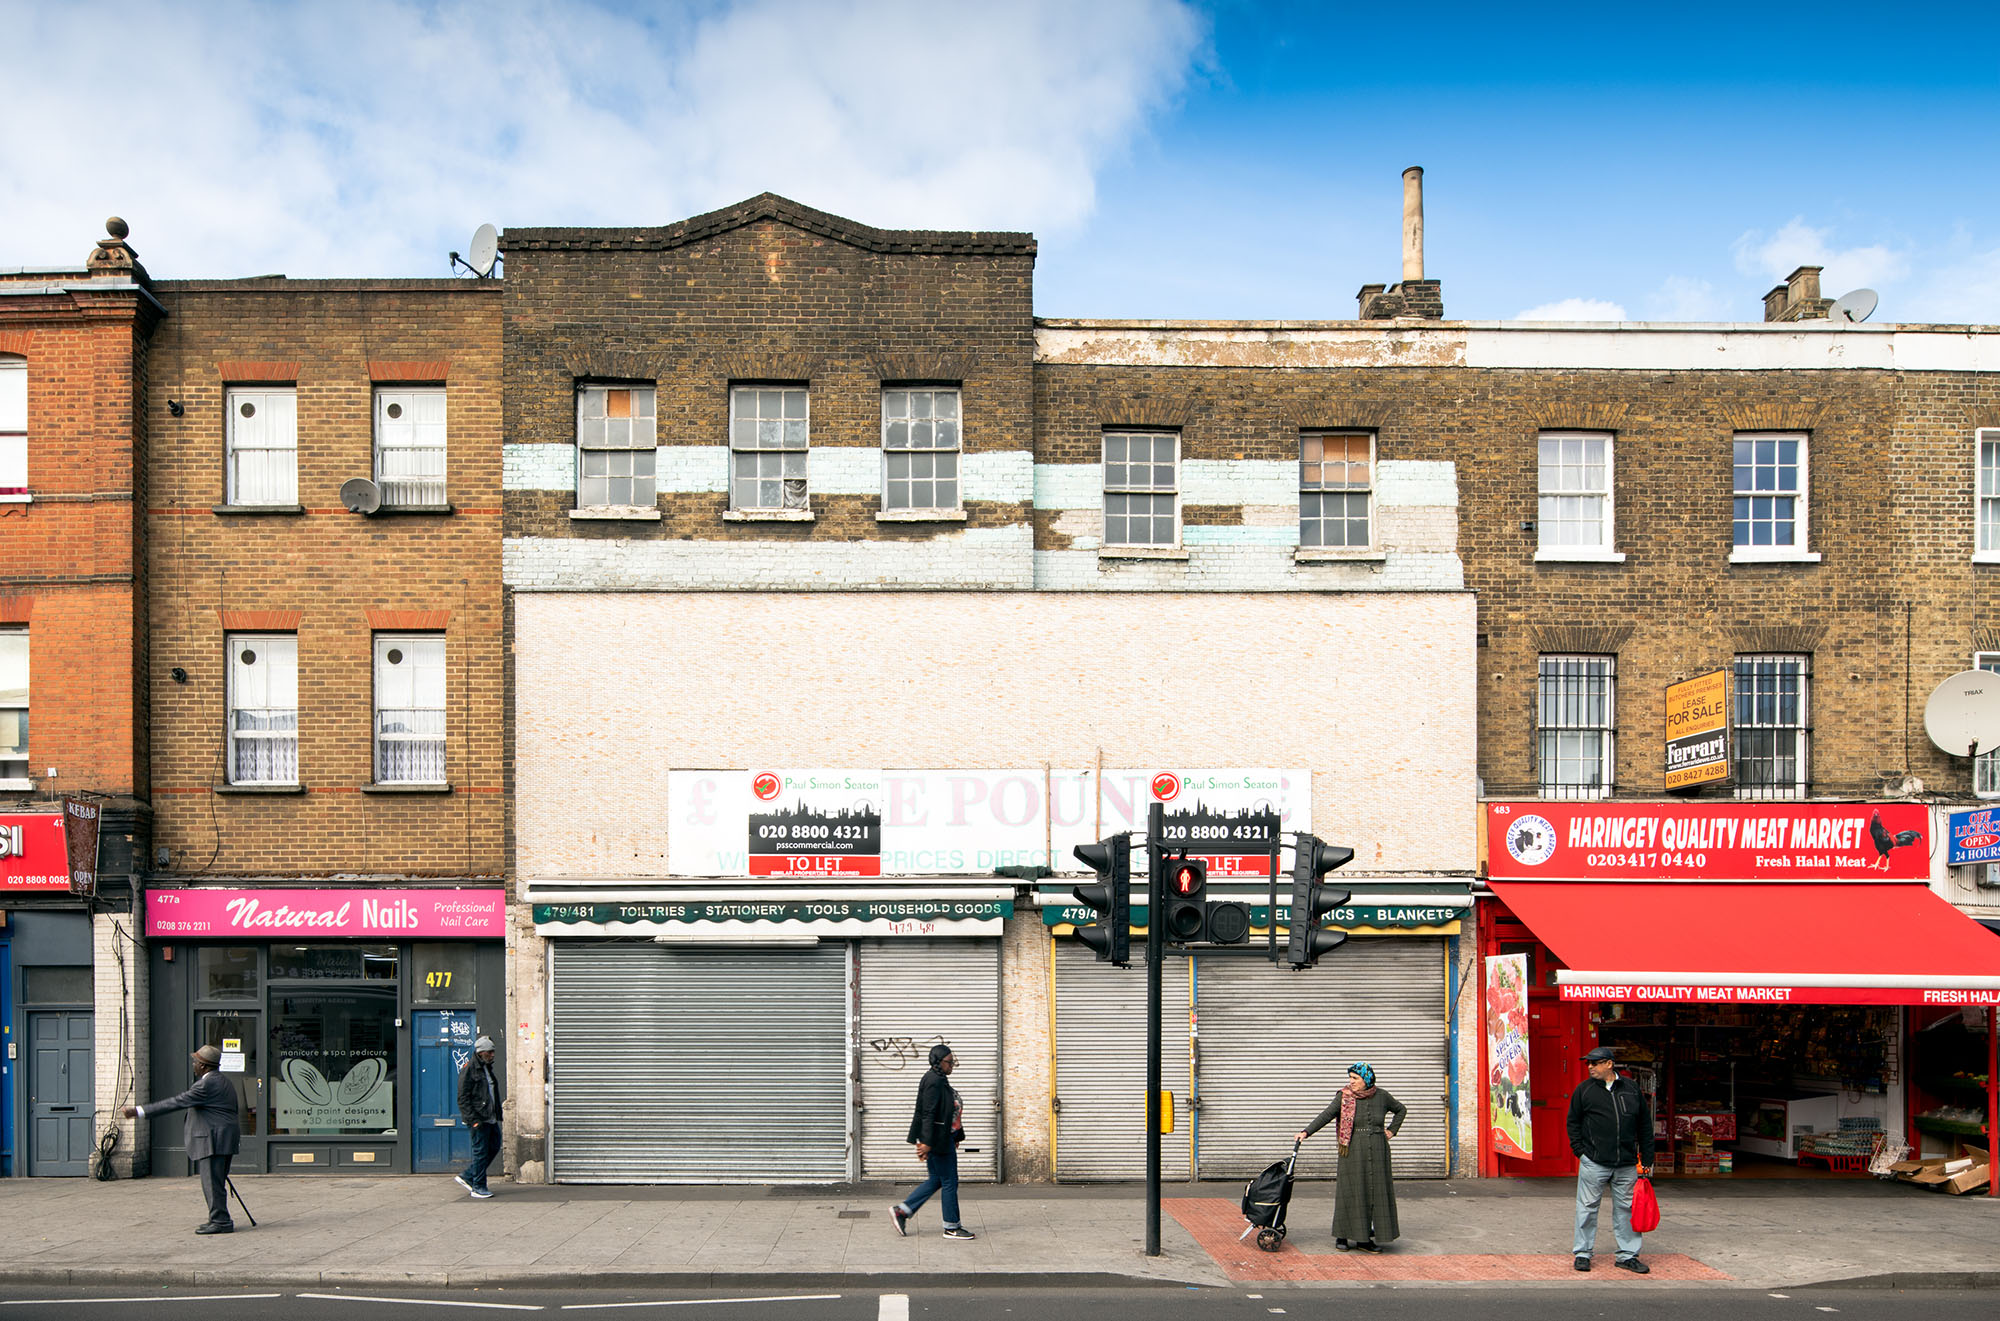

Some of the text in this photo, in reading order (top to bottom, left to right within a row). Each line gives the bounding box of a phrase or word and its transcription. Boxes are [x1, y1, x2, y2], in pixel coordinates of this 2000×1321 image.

[1694, 678, 1713, 687] FITTED
[1668, 681, 1723, 703] BUTCHERS PREMISES
[1964, 688, 1984, 697] TRIAX
[1682, 695, 1706, 709] LEASE
[1668, 701, 1723, 727] FOR SALE
[1675, 727, 1685, 735] ALL
[1667, 735, 1725, 765] Ferrari
[1667, 764, 1725, 785] 020 8427 4288
[785, 777, 879, 790] Paul Simon Seaton
[1183, 777, 1278, 790] Paul Simon Seaton
[946, 775, 1148, 828] POUN
[68, 801, 96, 819] KEBAB
[1493, 805, 1511, 815] 483
[1968, 810, 1992, 825] OFF
[759, 825, 869, 839] 020 8800 4321
[1190, 825, 1229, 839] 8800
[1232, 825, 1269, 839] 4321
[1568, 817, 1865, 852] HARINGEY QUALITY MEAT MARKET
[1955, 820, 2000, 838] LICENC
[776, 841, 853, 851] psscommercial.com
[1965, 835, 1991, 847] OPEN
[1661, 852, 1707, 867] 0440
[1755, 855, 1867, 867] Fresh Halal Meat
[1955, 850, 1966, 861] 24
[786, 856, 843, 871] TO LET
[1215, 856, 1243, 871] LET
[7, 876, 70, 884] 020 8808 0082
[73, 870, 93, 885] OPEN
[157, 895, 180, 904] 477a
[226, 897, 419, 929] Natural Nails
[433, 901, 496, 913] Professional
[543, 906, 594, 918] 479/481
[619, 906, 686, 917] TOILTRIES
[705, 905, 786, 916] STATIONERY
[806, 904, 850, 915] TOOLS
[869, 903, 950, 915] HOUSEHOLD
[954, 903, 1002, 914] GOODS
[1062, 908, 1097, 919] 479/4
[1377, 909, 1455, 920] BLANKETS
[156, 920, 211, 931] 0208 376 2211
[440, 916, 489, 927] Nail Care
[425, 971, 452, 988] 477
[1563, 985, 1792, 1001] HARINGEY QUALITY MEAT MARKET
[1924, 990, 1968, 1003] FRESH
[280, 1048, 388, 1058] manicure spa pedicure
[317, 1107, 341, 1116] paint
[344, 1106, 380, 1116] designs
[309, 1116, 361, 1126] 3D designs
